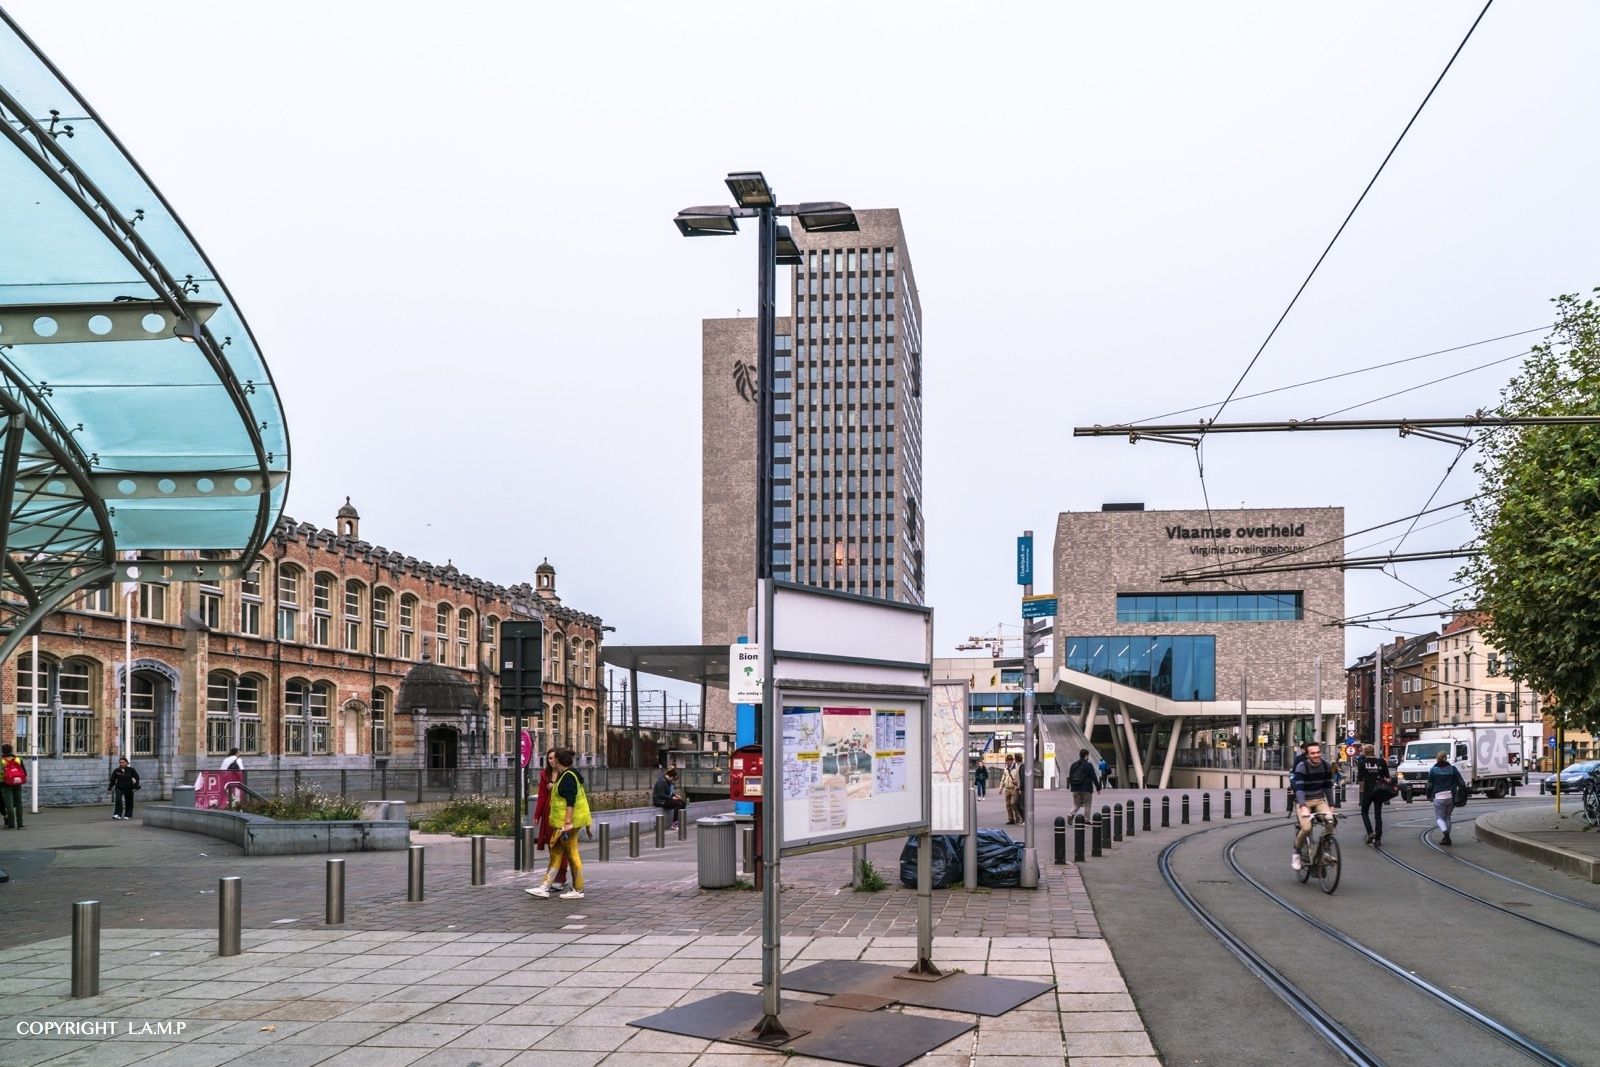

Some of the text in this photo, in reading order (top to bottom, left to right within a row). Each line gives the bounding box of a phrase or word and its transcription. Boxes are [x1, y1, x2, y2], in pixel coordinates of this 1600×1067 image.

[1165, 523, 1305, 539] Vlaamse overheid
[1190, 545, 1225, 556] Virginie
[208, 776, 217, 791] P
